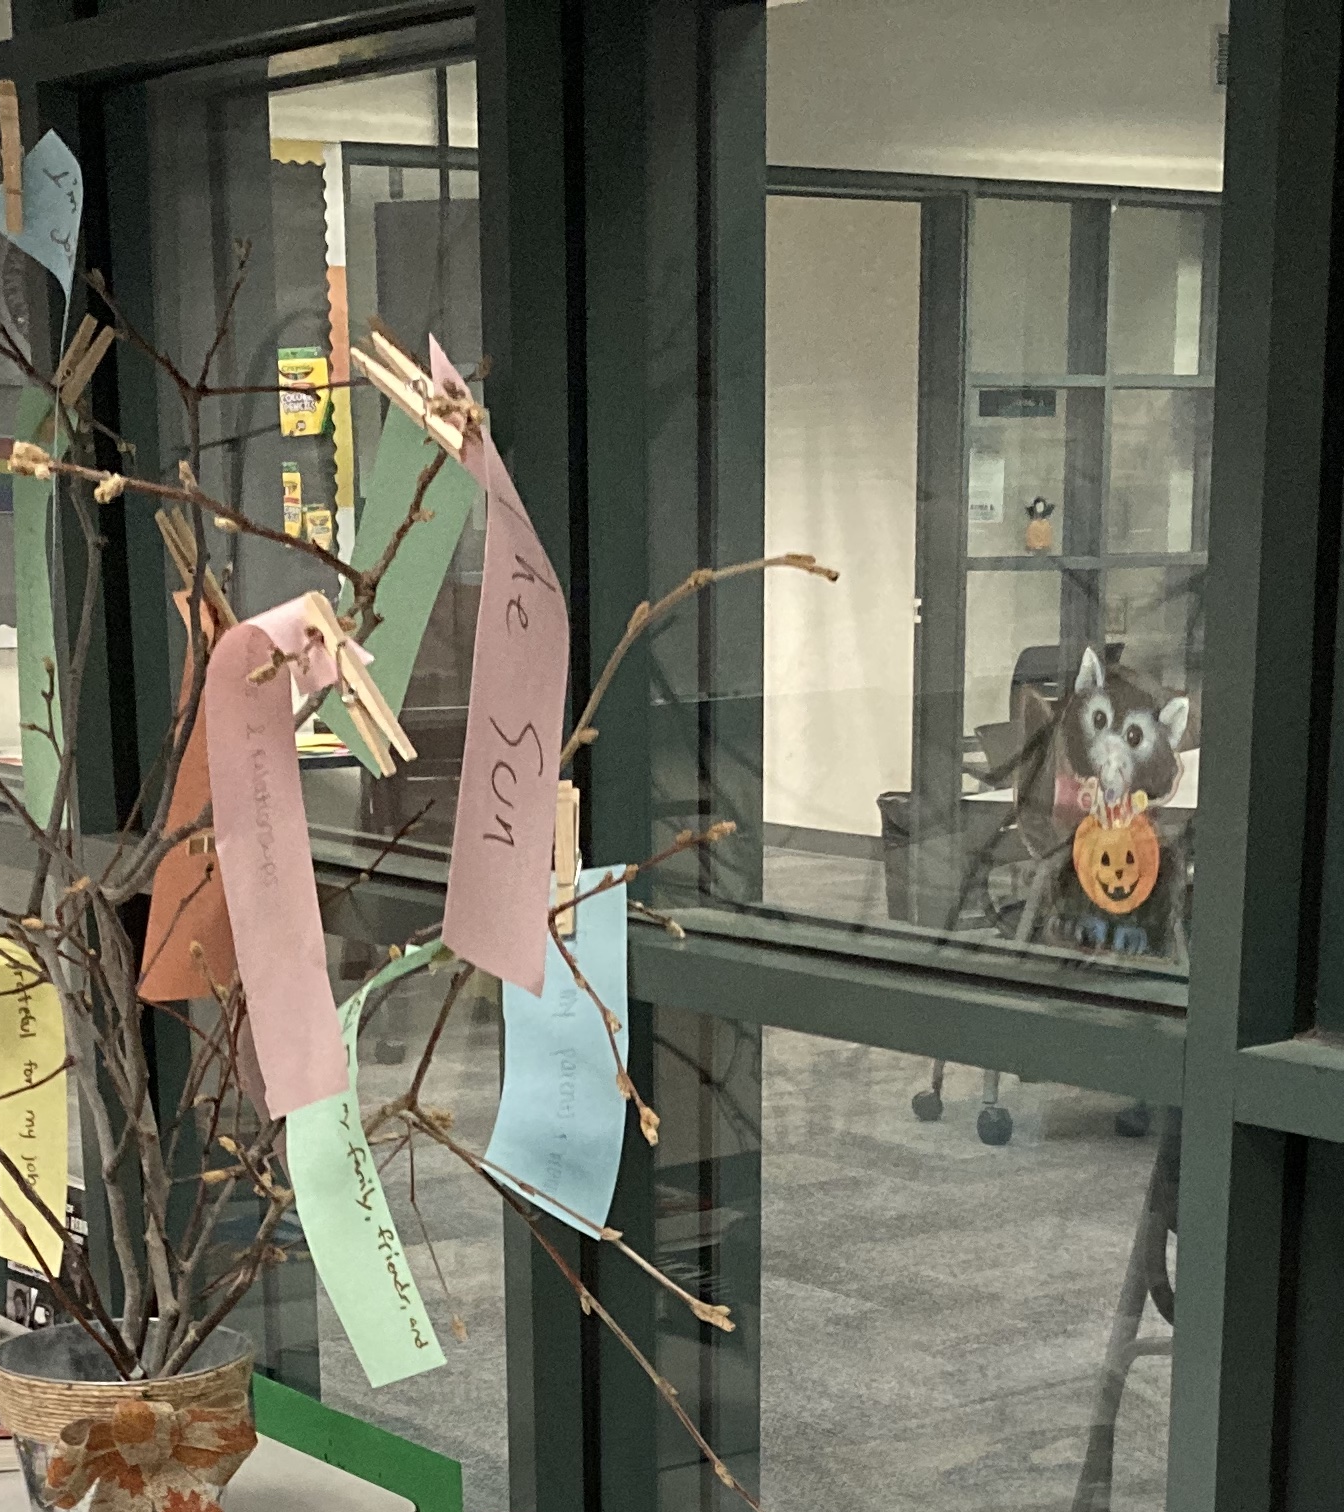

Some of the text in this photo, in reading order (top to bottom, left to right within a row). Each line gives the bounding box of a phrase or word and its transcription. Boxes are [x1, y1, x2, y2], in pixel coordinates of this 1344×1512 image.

[483, 715, 544, 847] Sun
[12, 964, 40, 1189] rateful for my job
[346, 1141, 375, 1224] family,
[376, 1225, 410, 1311] friends,
[408, 1315, 429, 1351] and
